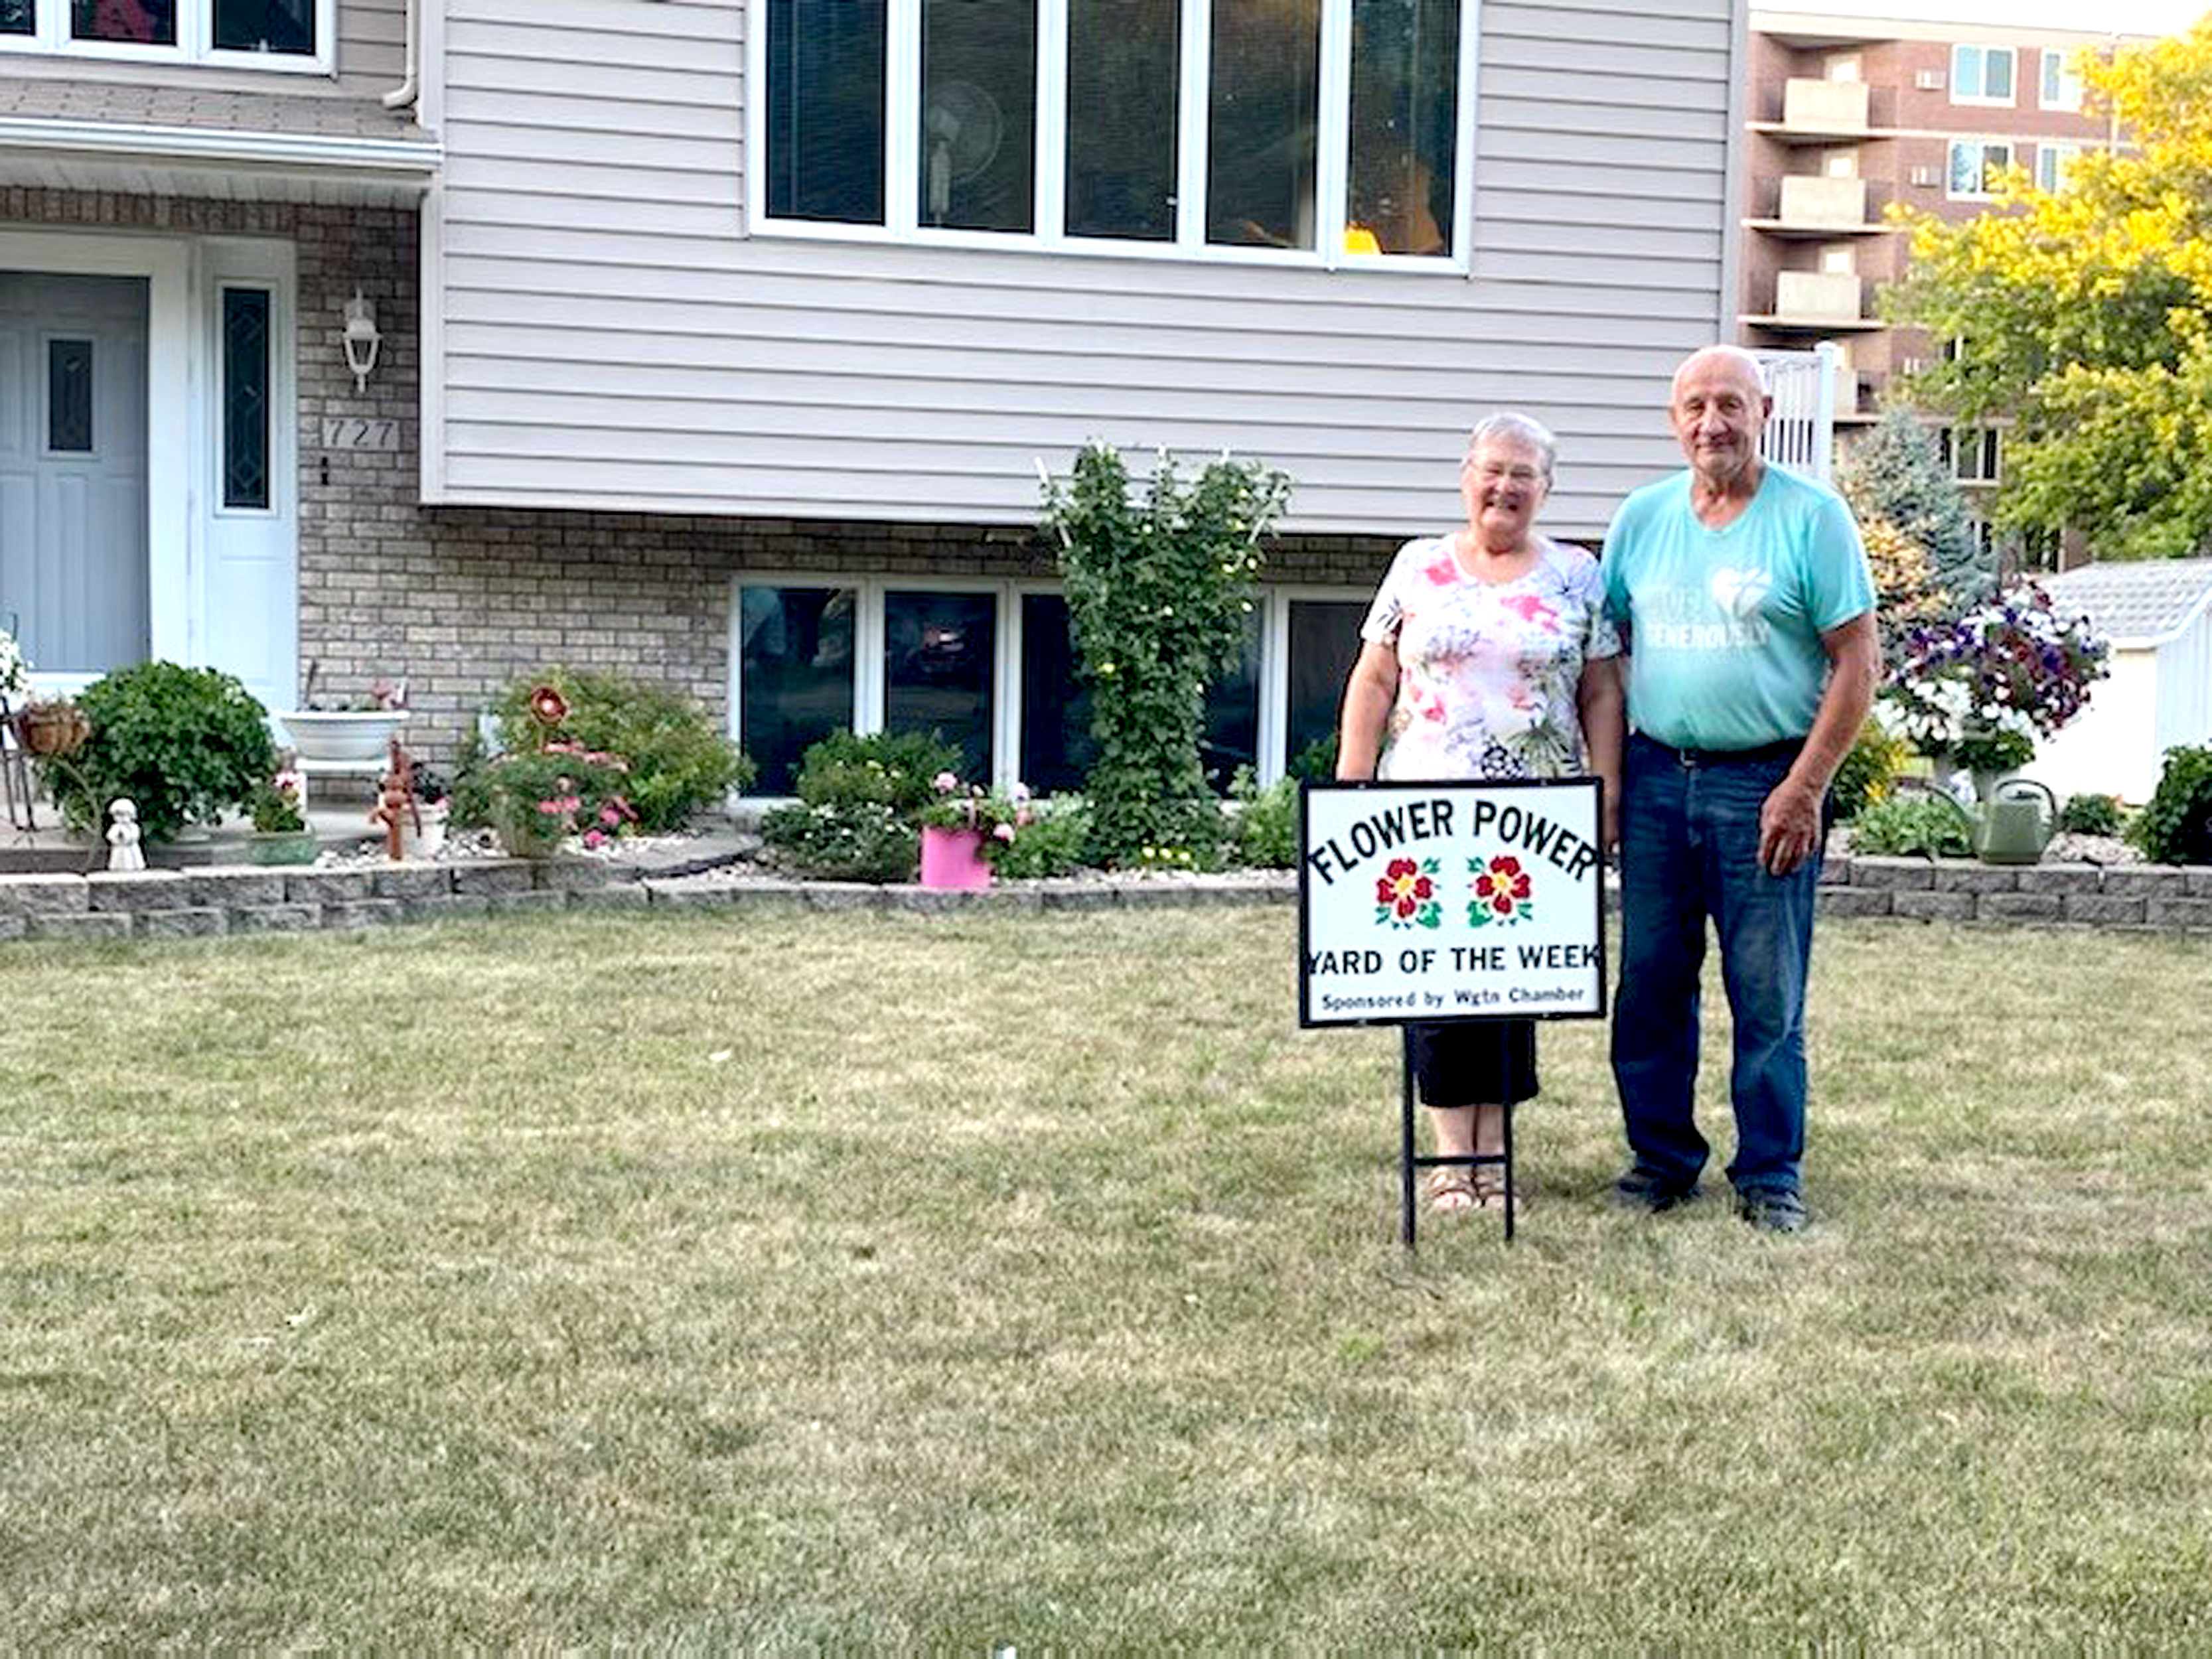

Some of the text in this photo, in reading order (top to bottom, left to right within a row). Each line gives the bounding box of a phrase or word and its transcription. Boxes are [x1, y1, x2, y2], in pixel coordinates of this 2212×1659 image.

[329, 420, 393, 446] 727
[1307, 800, 1600, 885] FLOWER POWER
[1307, 944, 1601, 974] YARD OF THE WEEK
[1321, 987, 1585, 1012] Sponsored by Wgtn Chamber
